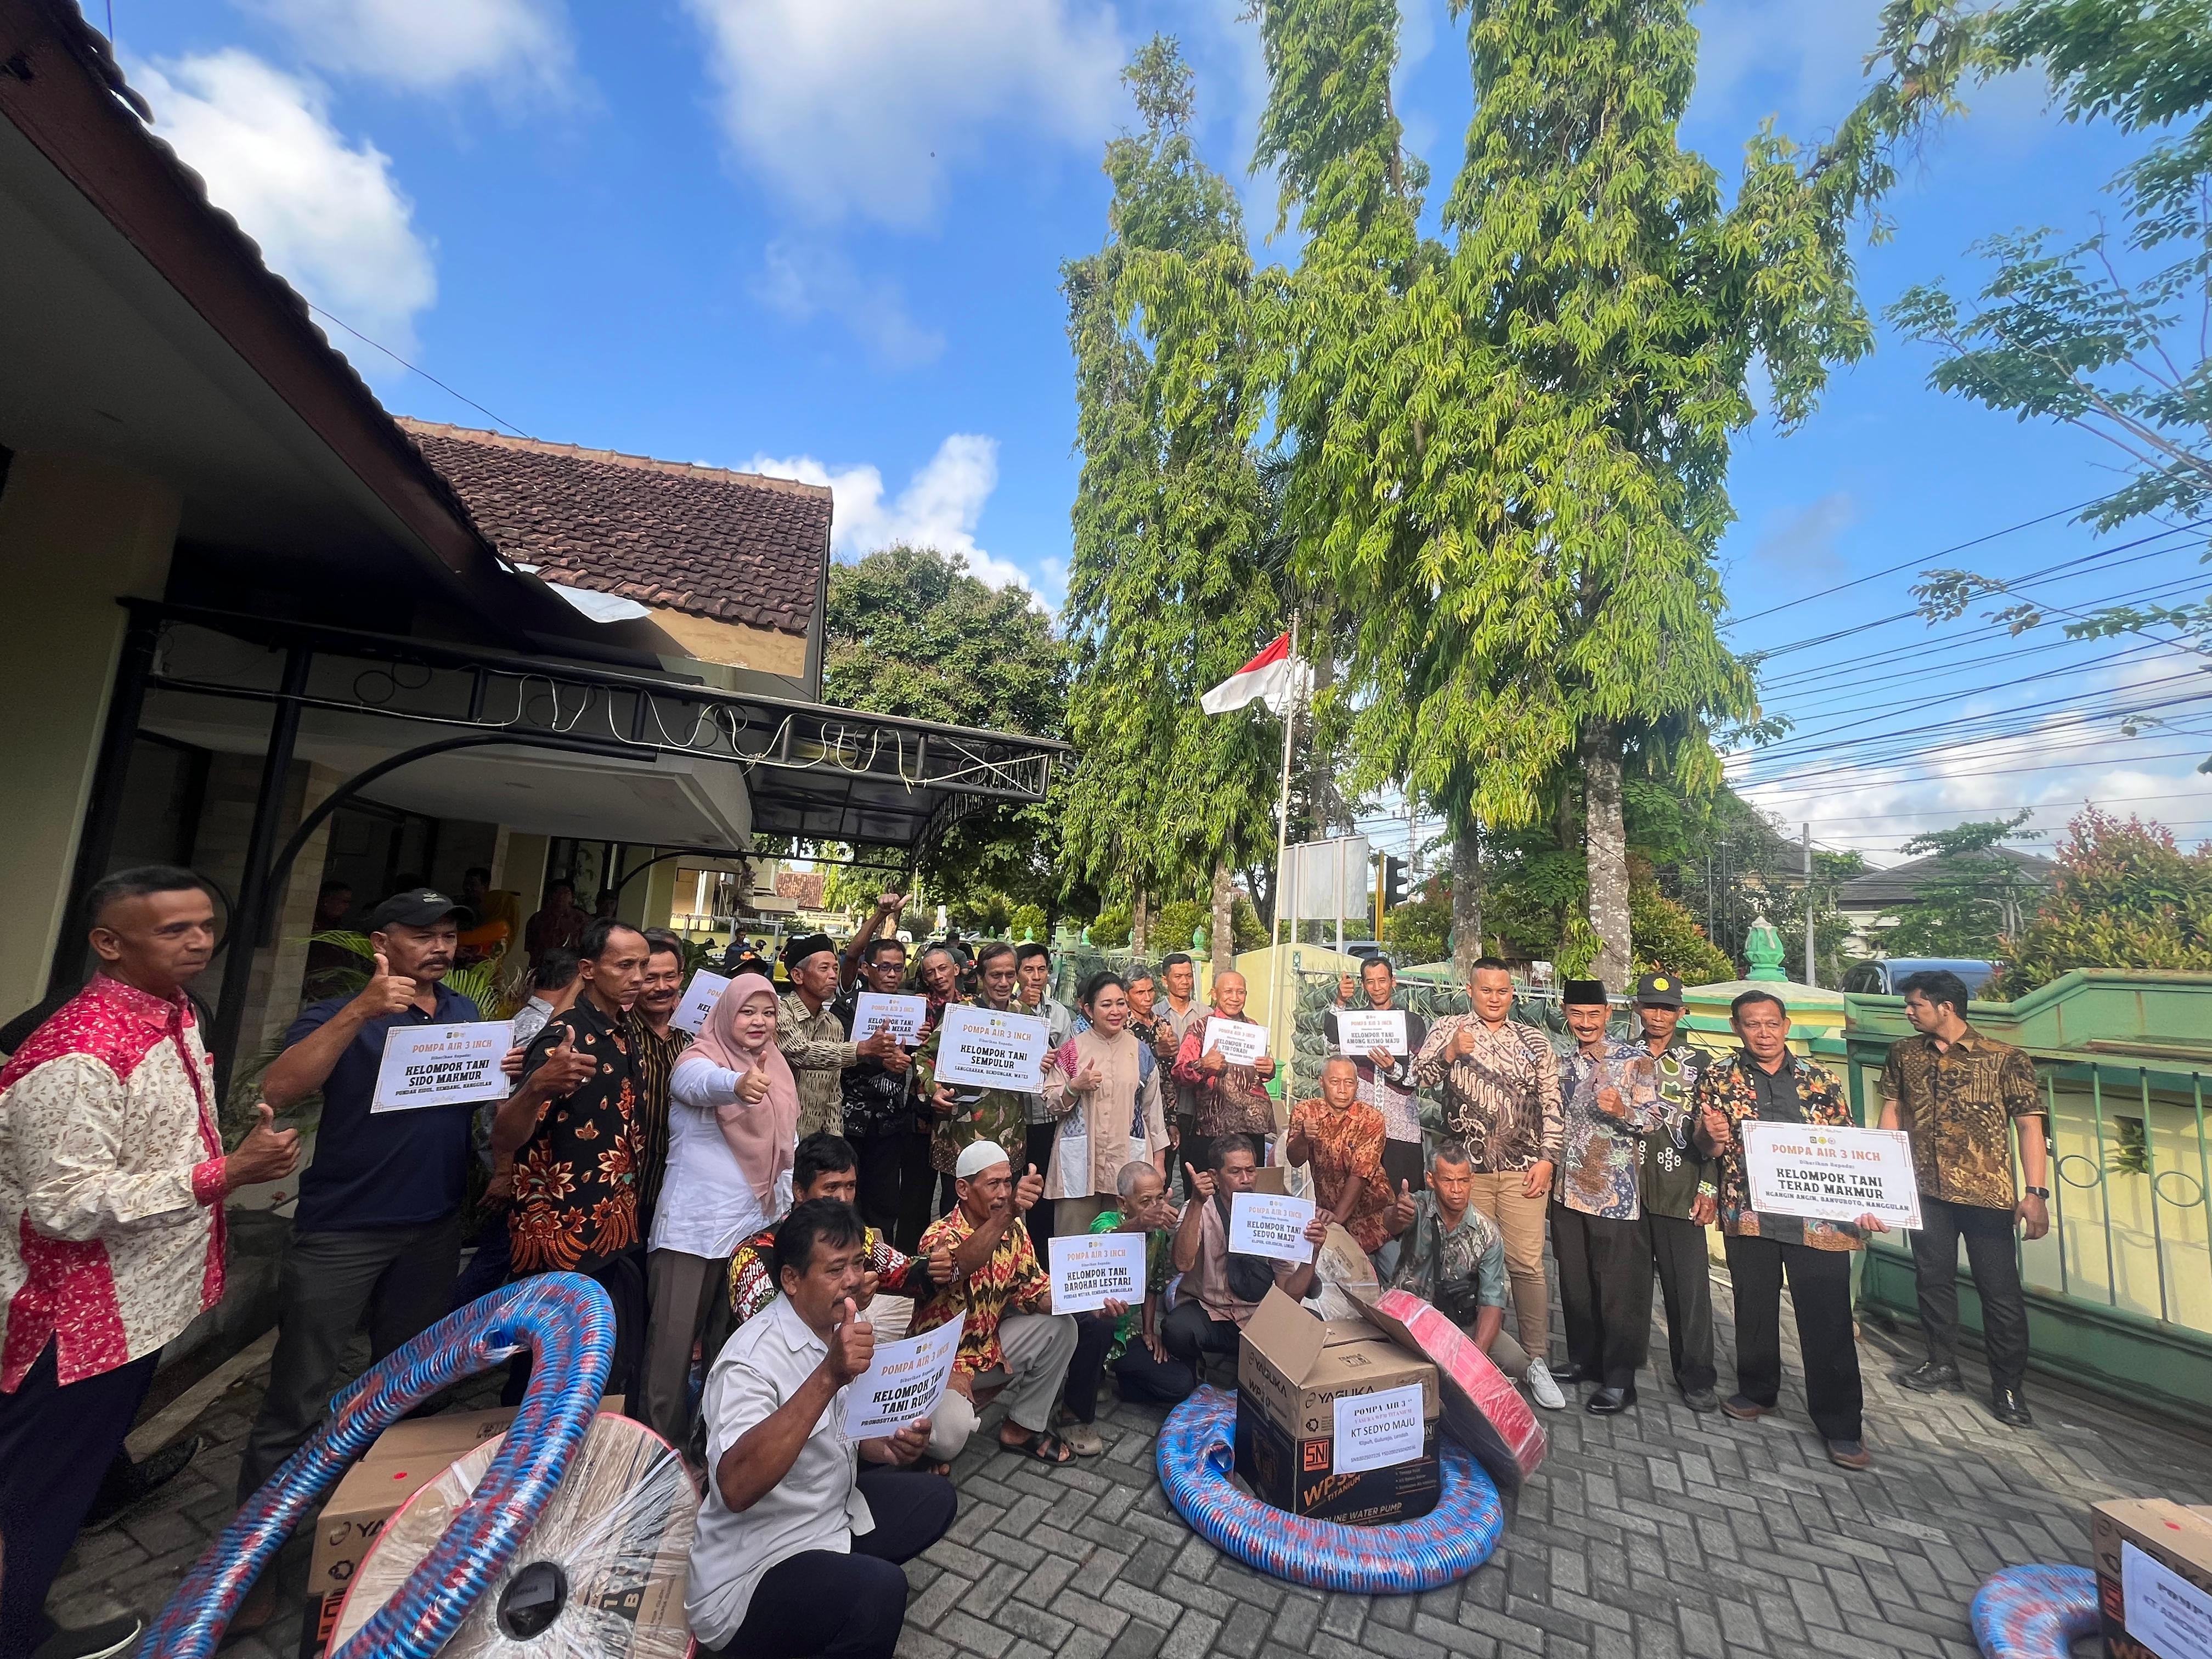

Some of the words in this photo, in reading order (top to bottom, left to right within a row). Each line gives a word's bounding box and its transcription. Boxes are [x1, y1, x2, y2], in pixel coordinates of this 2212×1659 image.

[707, 989, 721, 997] POM
[963, 1024, 989, 1035] POMPA
[991, 1028, 1005, 1037] AIR
[1014, 1031, 1031, 1041] INCH
[413, 1043, 444, 1053] POMPA
[447, 1041, 462, 1050] AIR
[465, 1041, 470, 1049] 3
[472, 1040, 493, 1049] INCH
[961, 1044, 1005, 1058] KELOMPOK
[1008, 1051, 1028, 1061] TANI
[1222, 1045, 1248, 1054] TIRTONADI
[405, 1062, 463, 1076] KELOMPOK
[466, 1059, 490, 1070] TANI
[971, 1056, 1014, 1069] SEMPULUR
[409, 1076, 433, 1087] SIDO
[436, 1070, 482, 1084] MAKMUR
[1771, 1144, 1813, 1156] POMPA
[1816, 1148, 1837, 1158] AIR
[1840, 1149, 1848, 1159] 3
[1852, 1150, 1881, 1161] INCH
[1776, 1168, 1847, 1183] KELOMPOK
[1849, 1175, 1883, 1187] TANI
[1778, 1180, 1820, 1193] TEKAD
[1824, 1183, 1884, 1200] MAKMUR
[1249, 1206, 1270, 1215] POMPA
[1866, 1200, 1910, 1212] NANGGULAN
[1247, 1221, 1285, 1232] KELOMPOK
[1286, 1225, 1301, 1234] TANI
[1253, 1230, 1275, 1239] SEDYO
[1277, 1232, 1295, 1242] MAJU
[1067, 1251, 1089, 1261] POMPA
[1091, 1250, 1102, 1259] AIR
[1067, 1268, 1106, 1281] KELOMPOK
[1108, 1267, 1127, 1277] TANI
[1064, 1279, 1098, 1293] BAROKAH
[1099, 1277, 1131, 1287] LESTARI
[881, 1360, 914, 1376] POMPA
[916, 1355, 930, 1368] AIR
[930, 1352, 935, 1362] 3
[936, 1342, 950, 1359] INCH
[872, 1378, 929, 1403] KELOMPOK
[930, 1365, 945, 1386] TANI
[1255, 1357, 1287, 1398] YASUKA
[882, 1400, 909, 1414] TANI
[910, 1384, 937, 1409] RUKUN
[1318, 1386, 1374, 1404] YASUKA
[1354, 1405, 1383, 1416] POMPA
[1385, 1401, 1400, 1410] AIR
[1351, 1427, 1362, 1438] KT
[1363, 1423, 1390, 1436] SEDYO
[1392, 1417, 1415, 1430] MAJU
[1306, 1443, 1328, 1466] SNI
[1327, 1474, 1361, 1502] TITANIUM
[1349, 1506, 1378, 1520] WATER
[1380, 1502, 1403, 1515] PUMP
